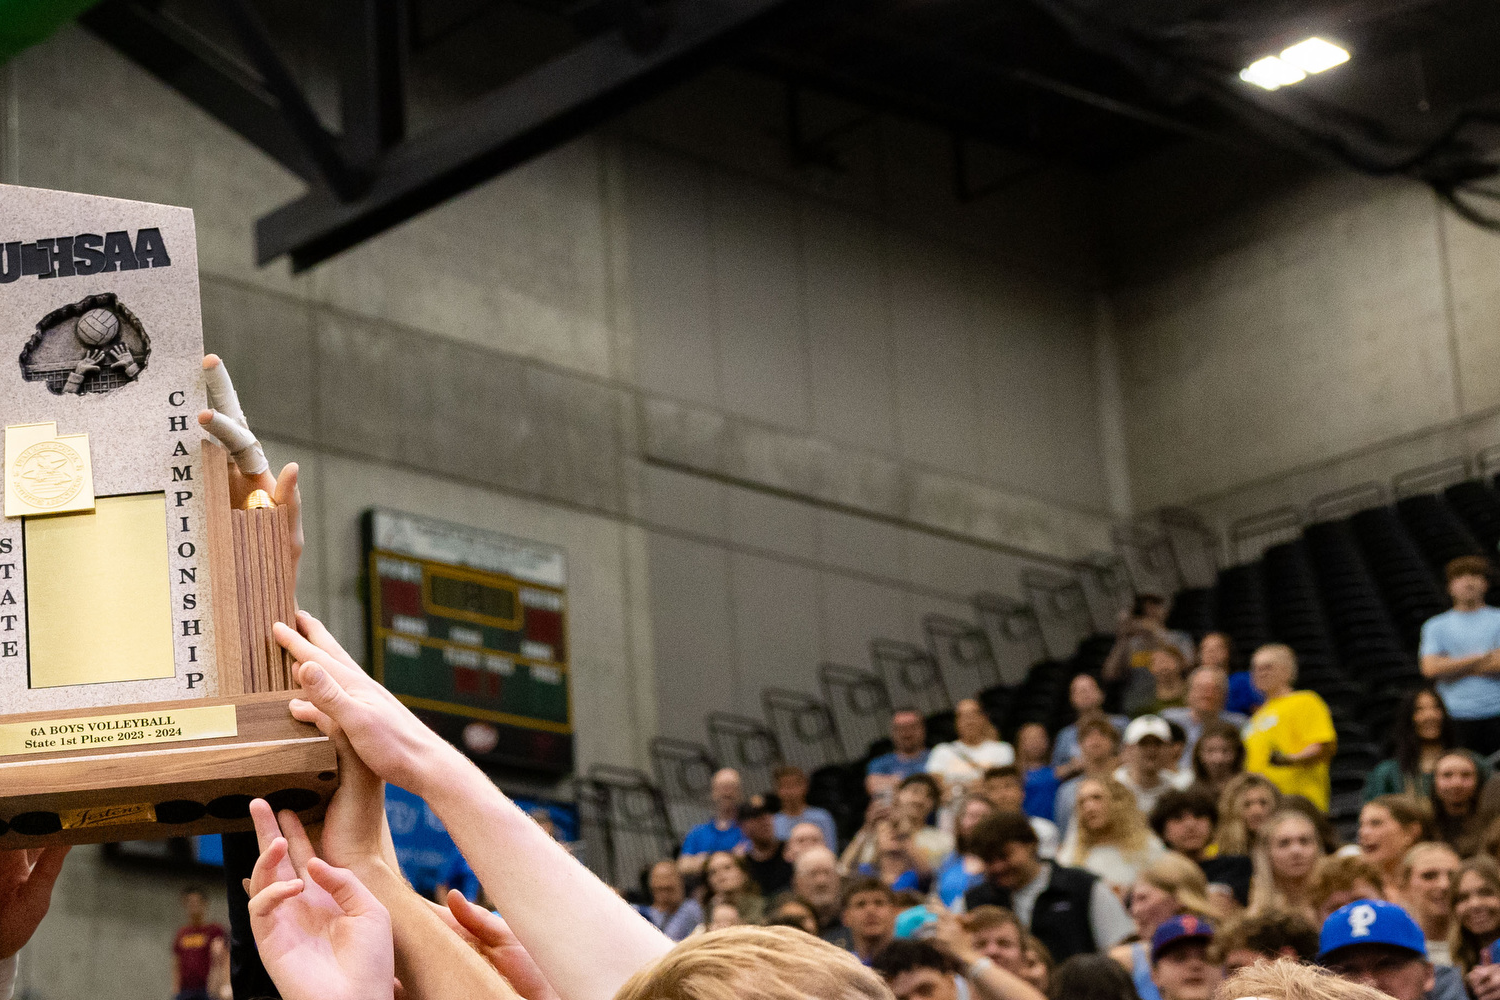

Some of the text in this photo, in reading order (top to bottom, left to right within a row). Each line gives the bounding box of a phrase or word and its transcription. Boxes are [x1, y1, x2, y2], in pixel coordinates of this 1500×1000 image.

[168, 391, 204, 690] CHAMPIONSHIP
[0, 538, 19, 659] STATE
[24, 738, 56, 749] State
[61, 737, 77, 746] 1st
[81, 734, 114, 745] Place
[117, 731, 144, 741] 2023
[155, 728, 183, 738] 2024
[30, 716, 176, 737] 6A BOYS VOLLEYBALL
